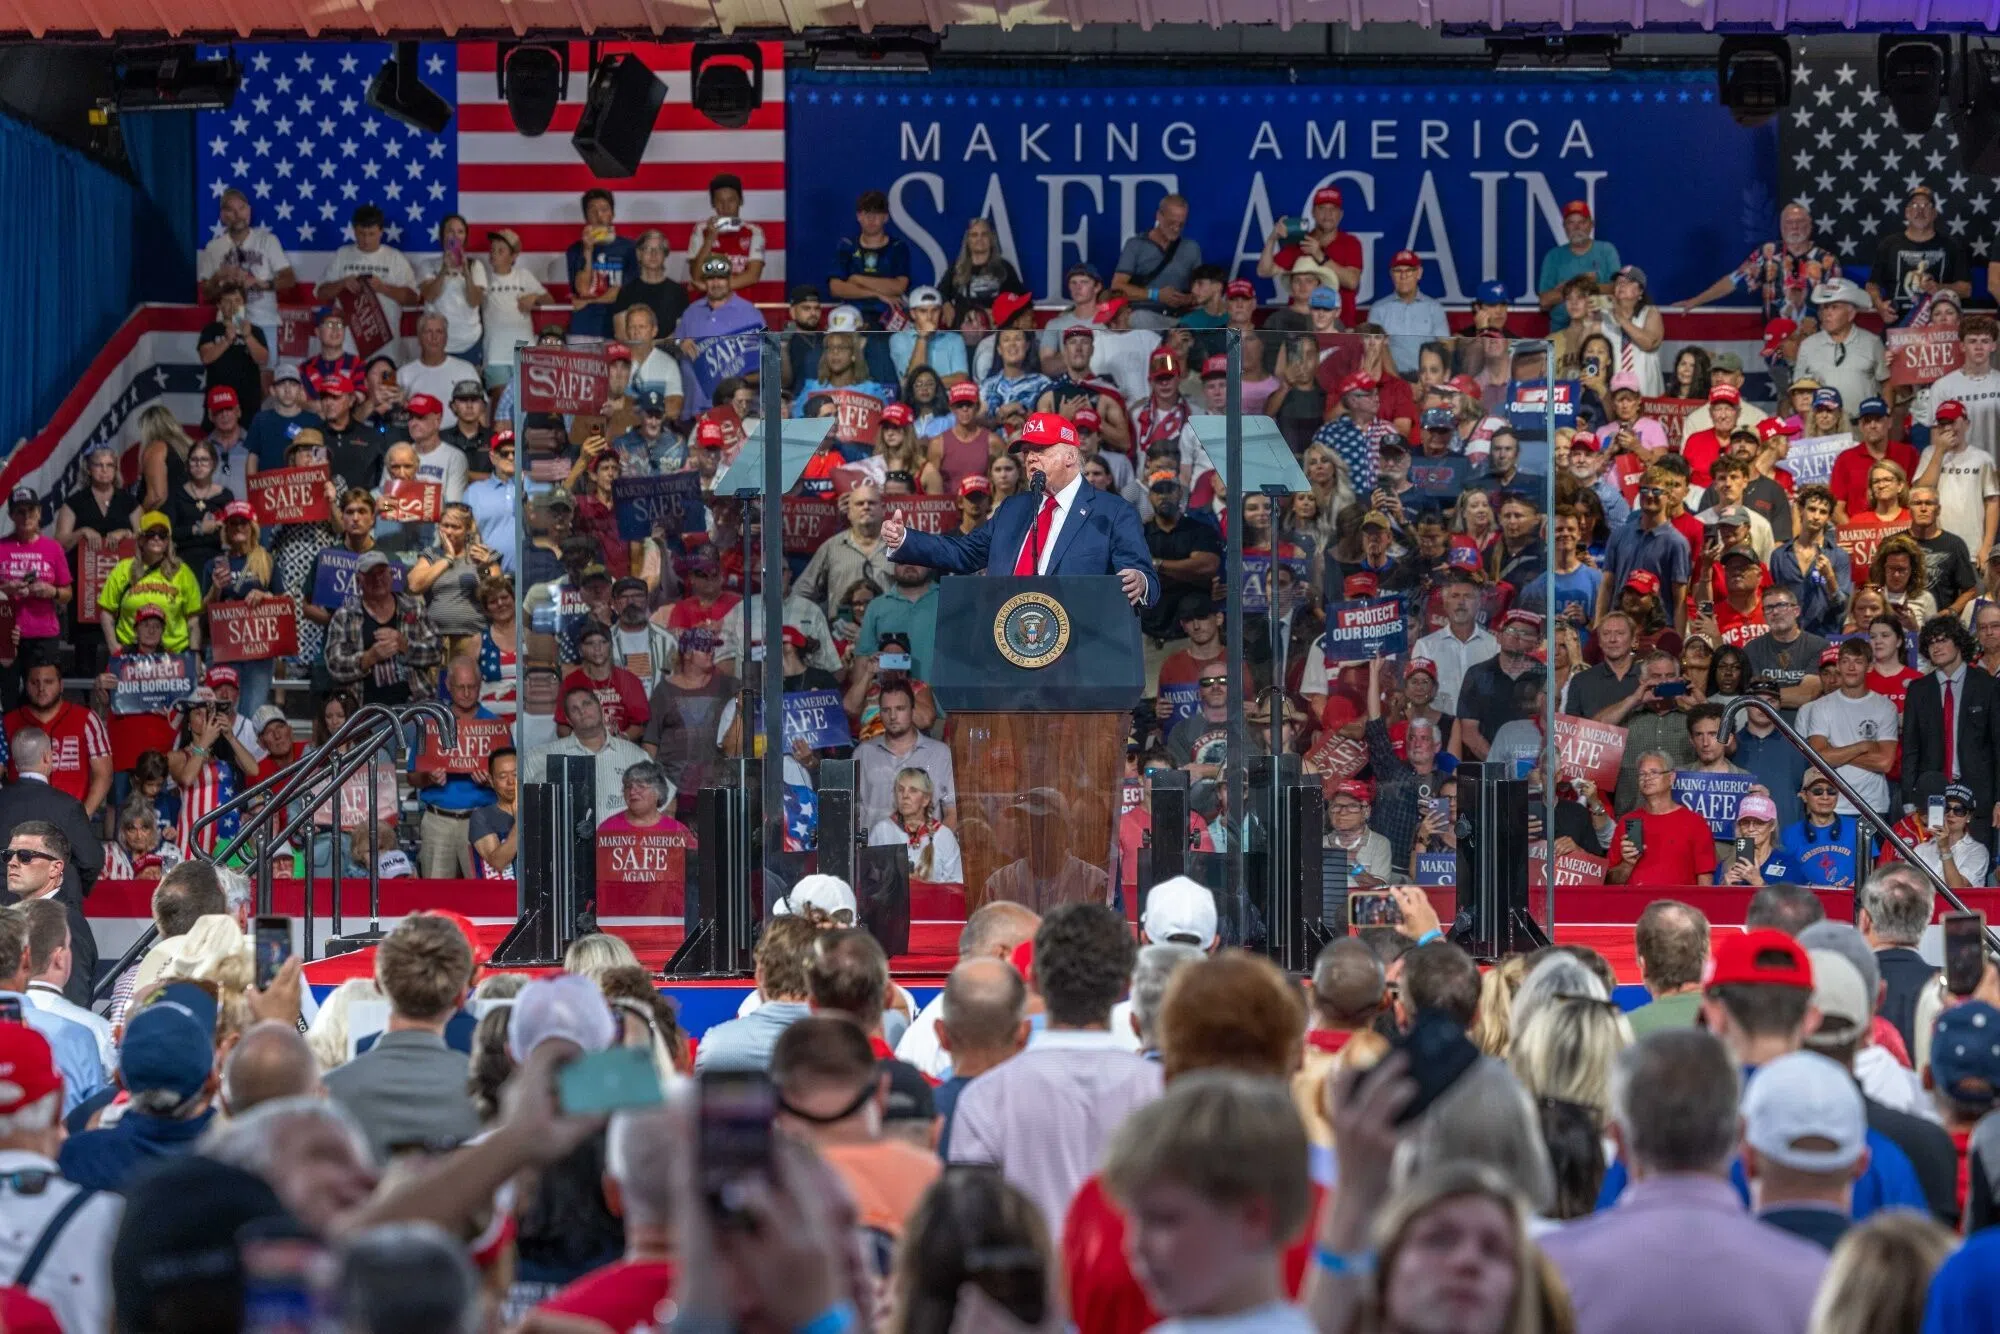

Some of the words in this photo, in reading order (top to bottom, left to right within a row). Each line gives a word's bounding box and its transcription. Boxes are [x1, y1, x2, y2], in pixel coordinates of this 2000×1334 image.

[901, 121, 1197, 163] MAKING
[1249, 119, 1595, 161] AMERICA
[1229, 170, 1608, 305] AGAIN
[1906, 342, 1955, 368] SAFE
[1918, 367, 1944, 378] AGAIN
[529, 366, 595, 402] SAFE
[844, 394, 882, 411] AMERICA
[837, 404, 870, 430] AFE
[249, 475, 285, 490] MAKING
[286, 470, 327, 486] AMERICA
[1941, 467, 1980, 475] EEDOM
[264, 484, 314, 511] SAFE
[633, 494, 686, 522] SAFE
[885, 501, 914, 512] AKING
[915, 500, 957, 512] AMERICA
[275, 506, 304, 520] AGAIN
[903, 513, 942, 535] AFE
[782, 515, 821, 538] AFE
[1839, 528, 1876, 541] MAKING
[1855, 541, 1878, 566] SA
[334, 569, 364, 594] SA
[212, 606, 247, 620] MAKING
[248, 603, 293, 618] AMERICA
[996, 595, 1031, 629] PRESIDENT
[1051, 603, 1068, 635] UNITED
[1344, 604, 1395, 627] PROTECT
[228, 616, 280, 645] SAFE
[1333, 626, 1362, 642] OUR
[1363, 620, 1403, 640] BORDERS
[1722, 628, 1740, 645] NC
[1741, 623, 1771, 640] STAT
[242, 642, 270, 656] AGAIN
[1006, 650, 1026, 665] SEAL
[1039, 641, 1064, 664] STATES
[126, 660, 181, 680] PROTECT
[117, 679, 140, 695] OUR
[141, 677, 191, 693] BORDERS
[792, 695, 839, 710] AMERICA
[463, 724, 508, 736] AMERICA
[784, 708, 828, 735] AFE
[1555, 719, 1577, 736] KING
[1578, 726, 1623, 749] AMERICA
[437, 736, 492, 757] SAFE
[448, 756, 480, 769] AGAIN
[1317, 738, 1369, 780] SAFE
[1681, 793, 1737, 820] SAFE
[599, 835, 636, 847] MAKING
[640, 835, 686, 848] AMERICA
[1831, 845, 1852, 856] PRAYER
[380, 857, 406, 871] TRUMP
[612, 847, 667, 872] SAFE
[1420, 860, 1457, 873] MAKIN
[1556, 857, 1602, 878] AMERICA
[622, 871, 656, 882] AGAIN
